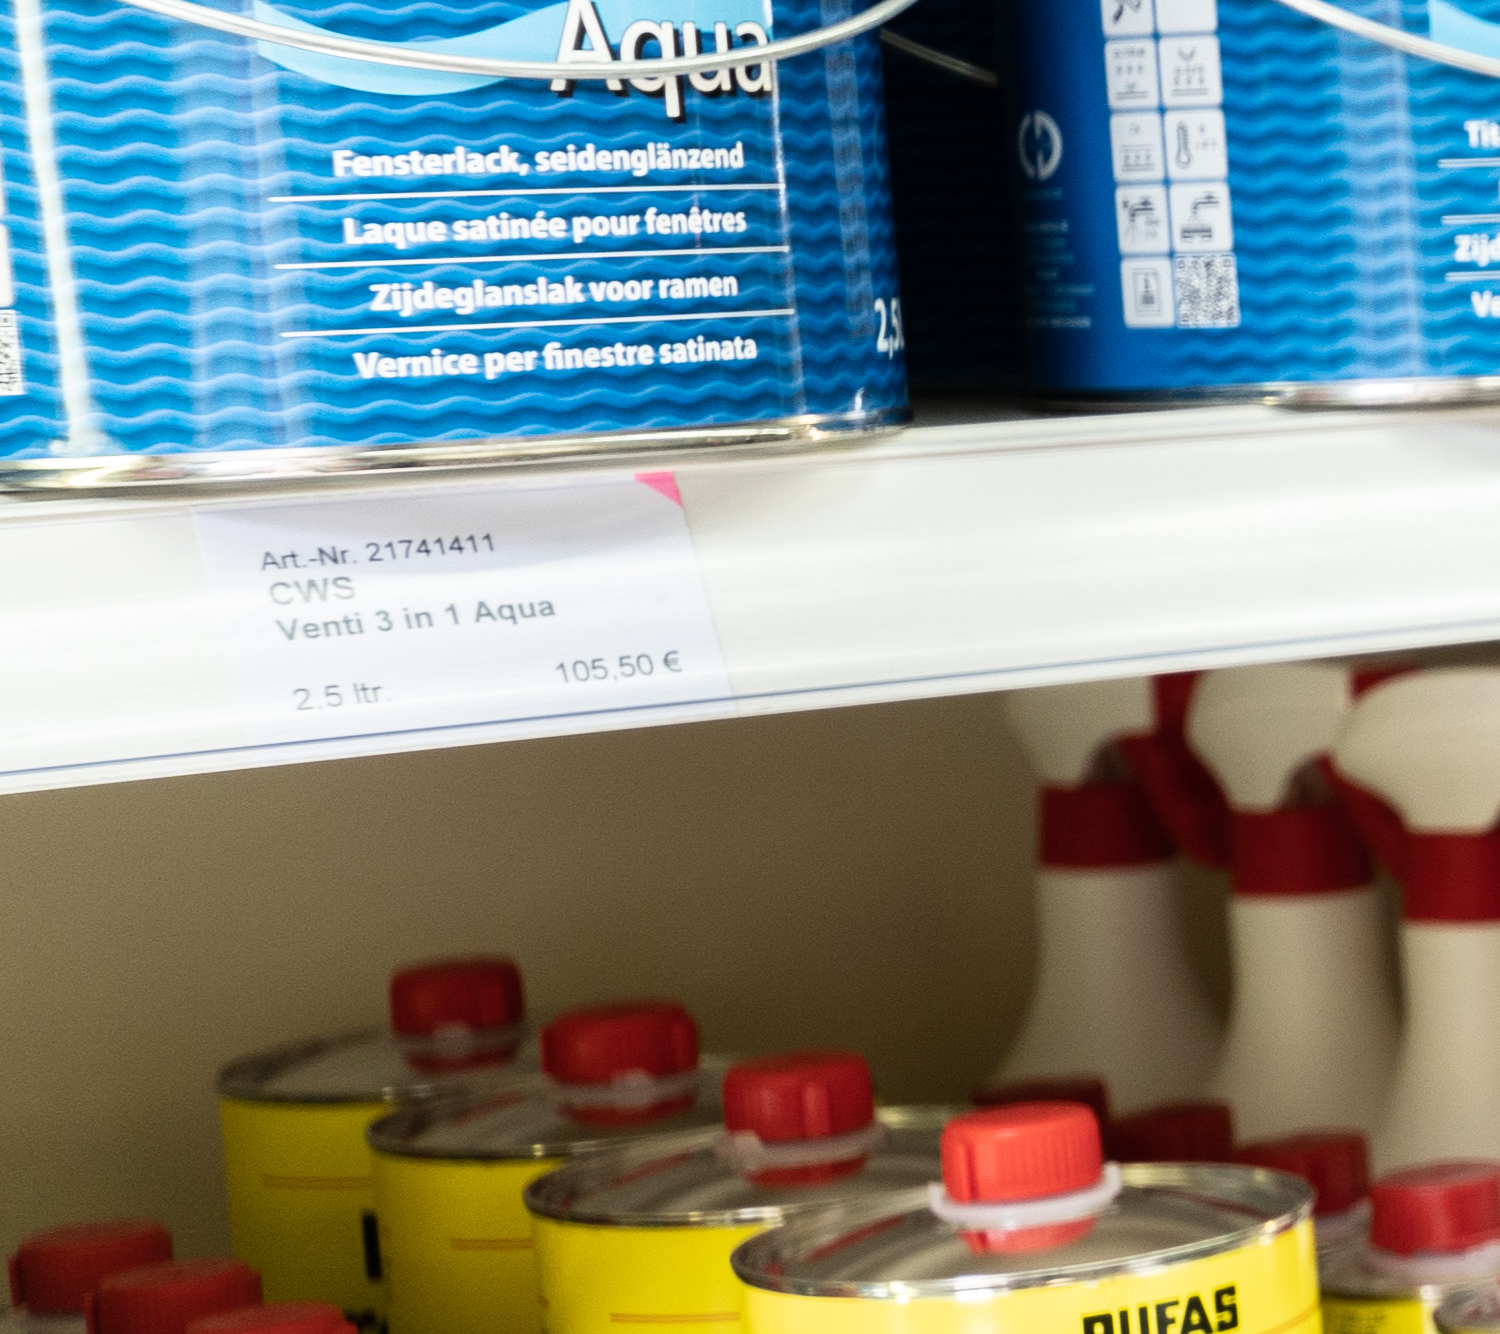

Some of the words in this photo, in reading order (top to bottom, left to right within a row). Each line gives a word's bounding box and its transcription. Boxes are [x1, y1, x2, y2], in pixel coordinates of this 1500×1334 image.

[334, 144, 529, 179] Fensterlack,
[534, 140, 745, 178] seidenglänzend
[343, 218, 446, 253] Laque
[453, 211, 566, 243] satinée
[571, 214, 639, 244] pour
[644, 205, 748, 237] fenêtres
[370, 278, 585, 317] Zijdeglanslak
[588, 279, 654, 305] voor
[659, 274, 739, 300] ramen
[354, 350, 478, 382] Vernice
[484, 350, 540, 379] per
[545, 339, 655, 372] finestre
[659, 335, 759, 366] satinata
[366, 533, 495, 563] 21741411
[270, 576, 355, 606] CWS
[277, 613, 363, 642] Venti
[377, 611, 393, 633] 3
[406, 605, 433, 630] in
[445, 604, 461, 626] 1
[475, 600, 556, 627] Aqua
[555, 654, 654, 685] 105,50
[664, 651, 683, 674] €
